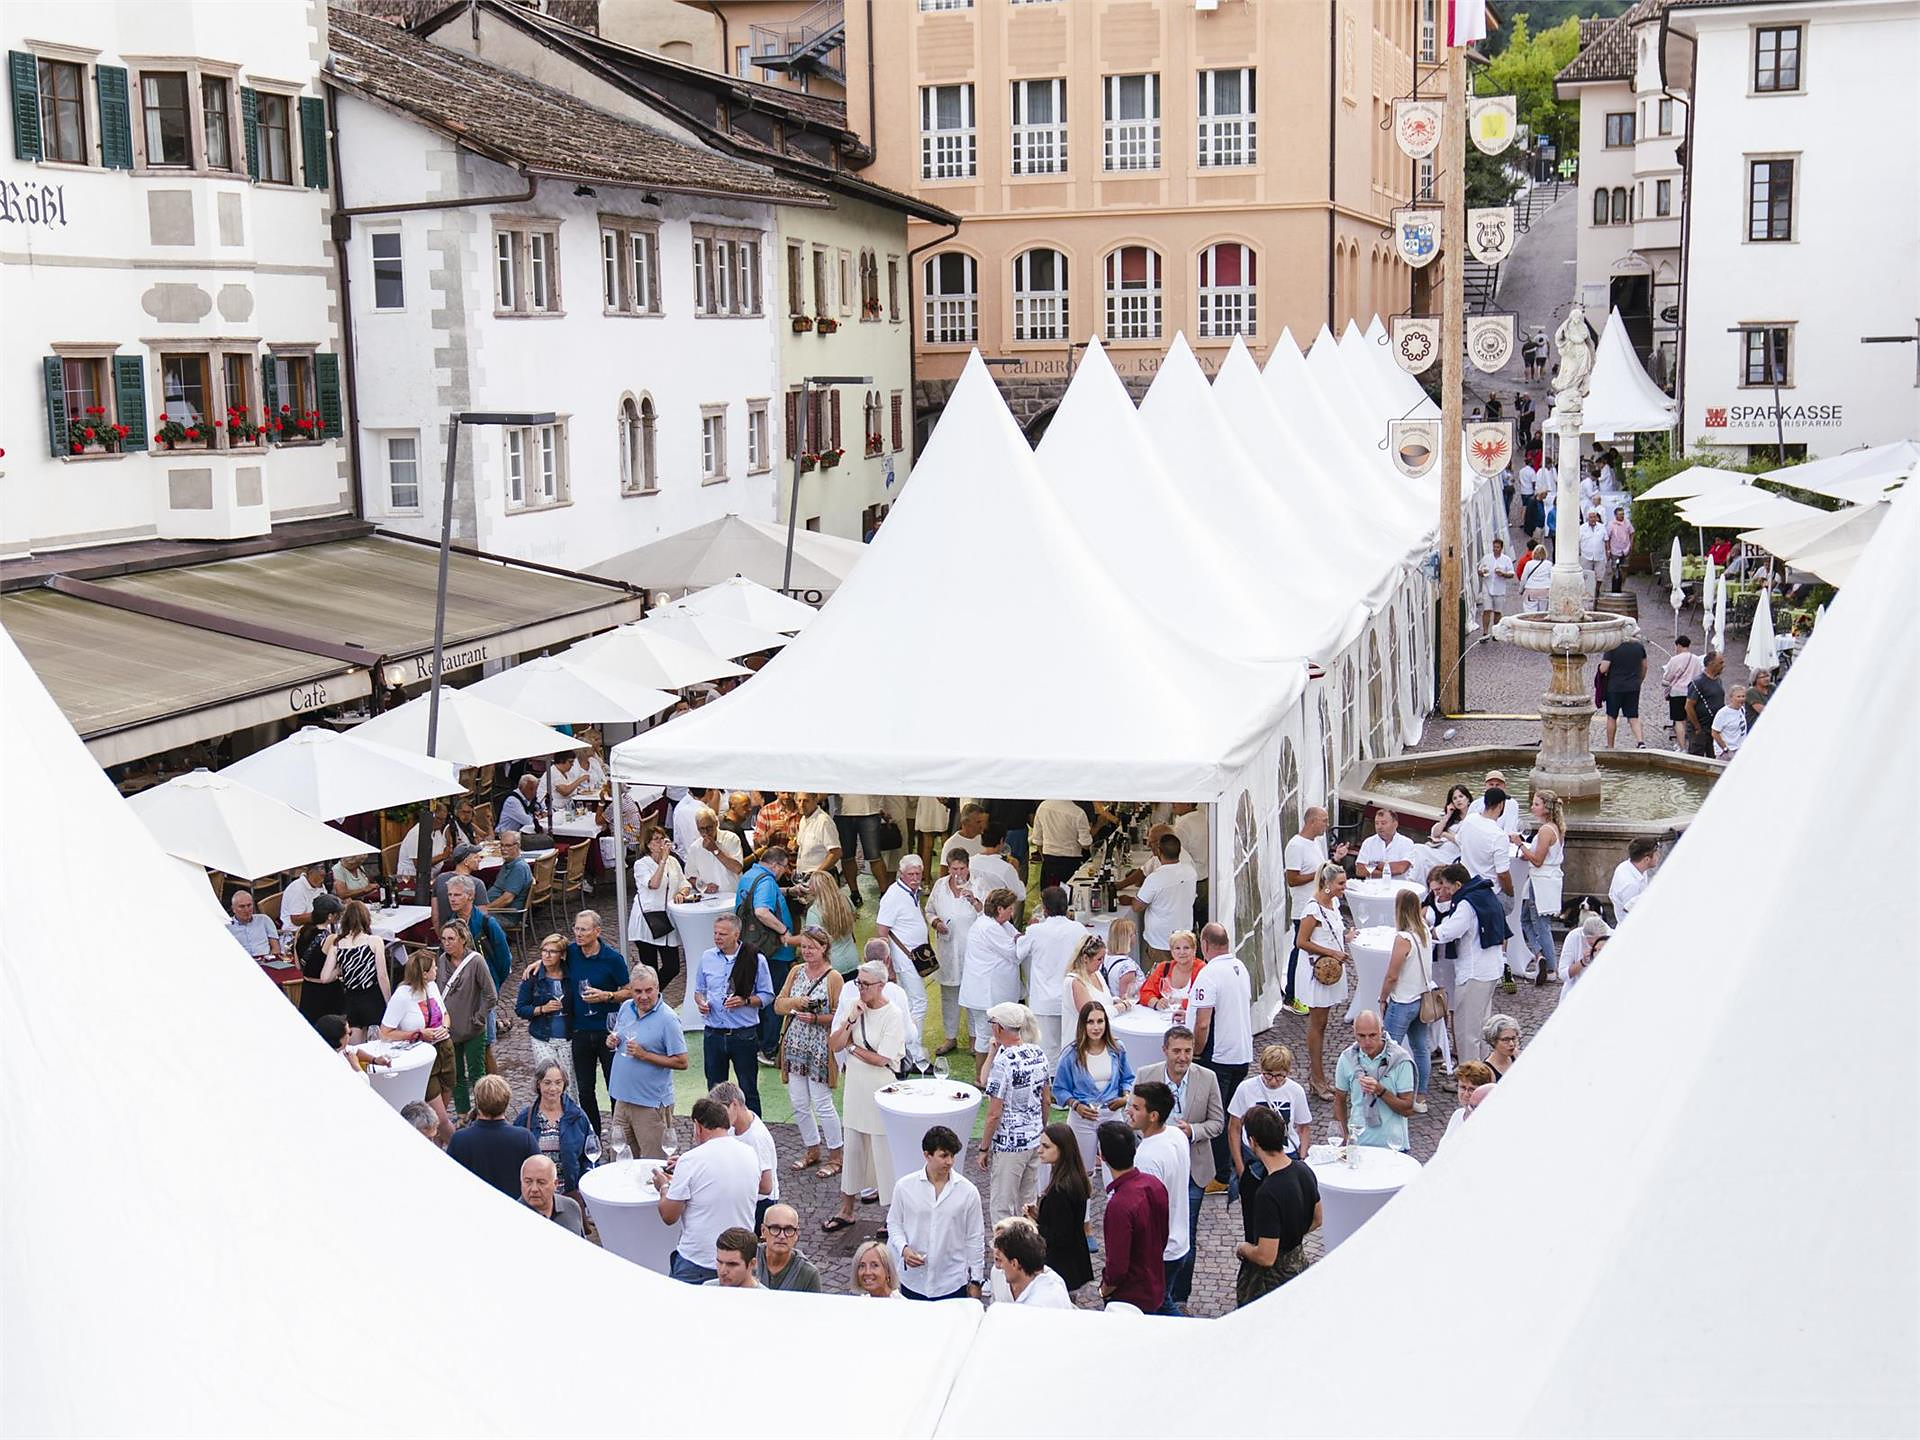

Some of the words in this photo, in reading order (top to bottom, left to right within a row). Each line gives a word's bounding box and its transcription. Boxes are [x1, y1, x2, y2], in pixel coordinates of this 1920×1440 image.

[1730, 405, 1842, 420] SPARKASSE
[1784, 420, 1842, 428] RISPARMIO
[416, 646, 488, 679] Retaurant
[289, 682, 327, 712] Cafè
